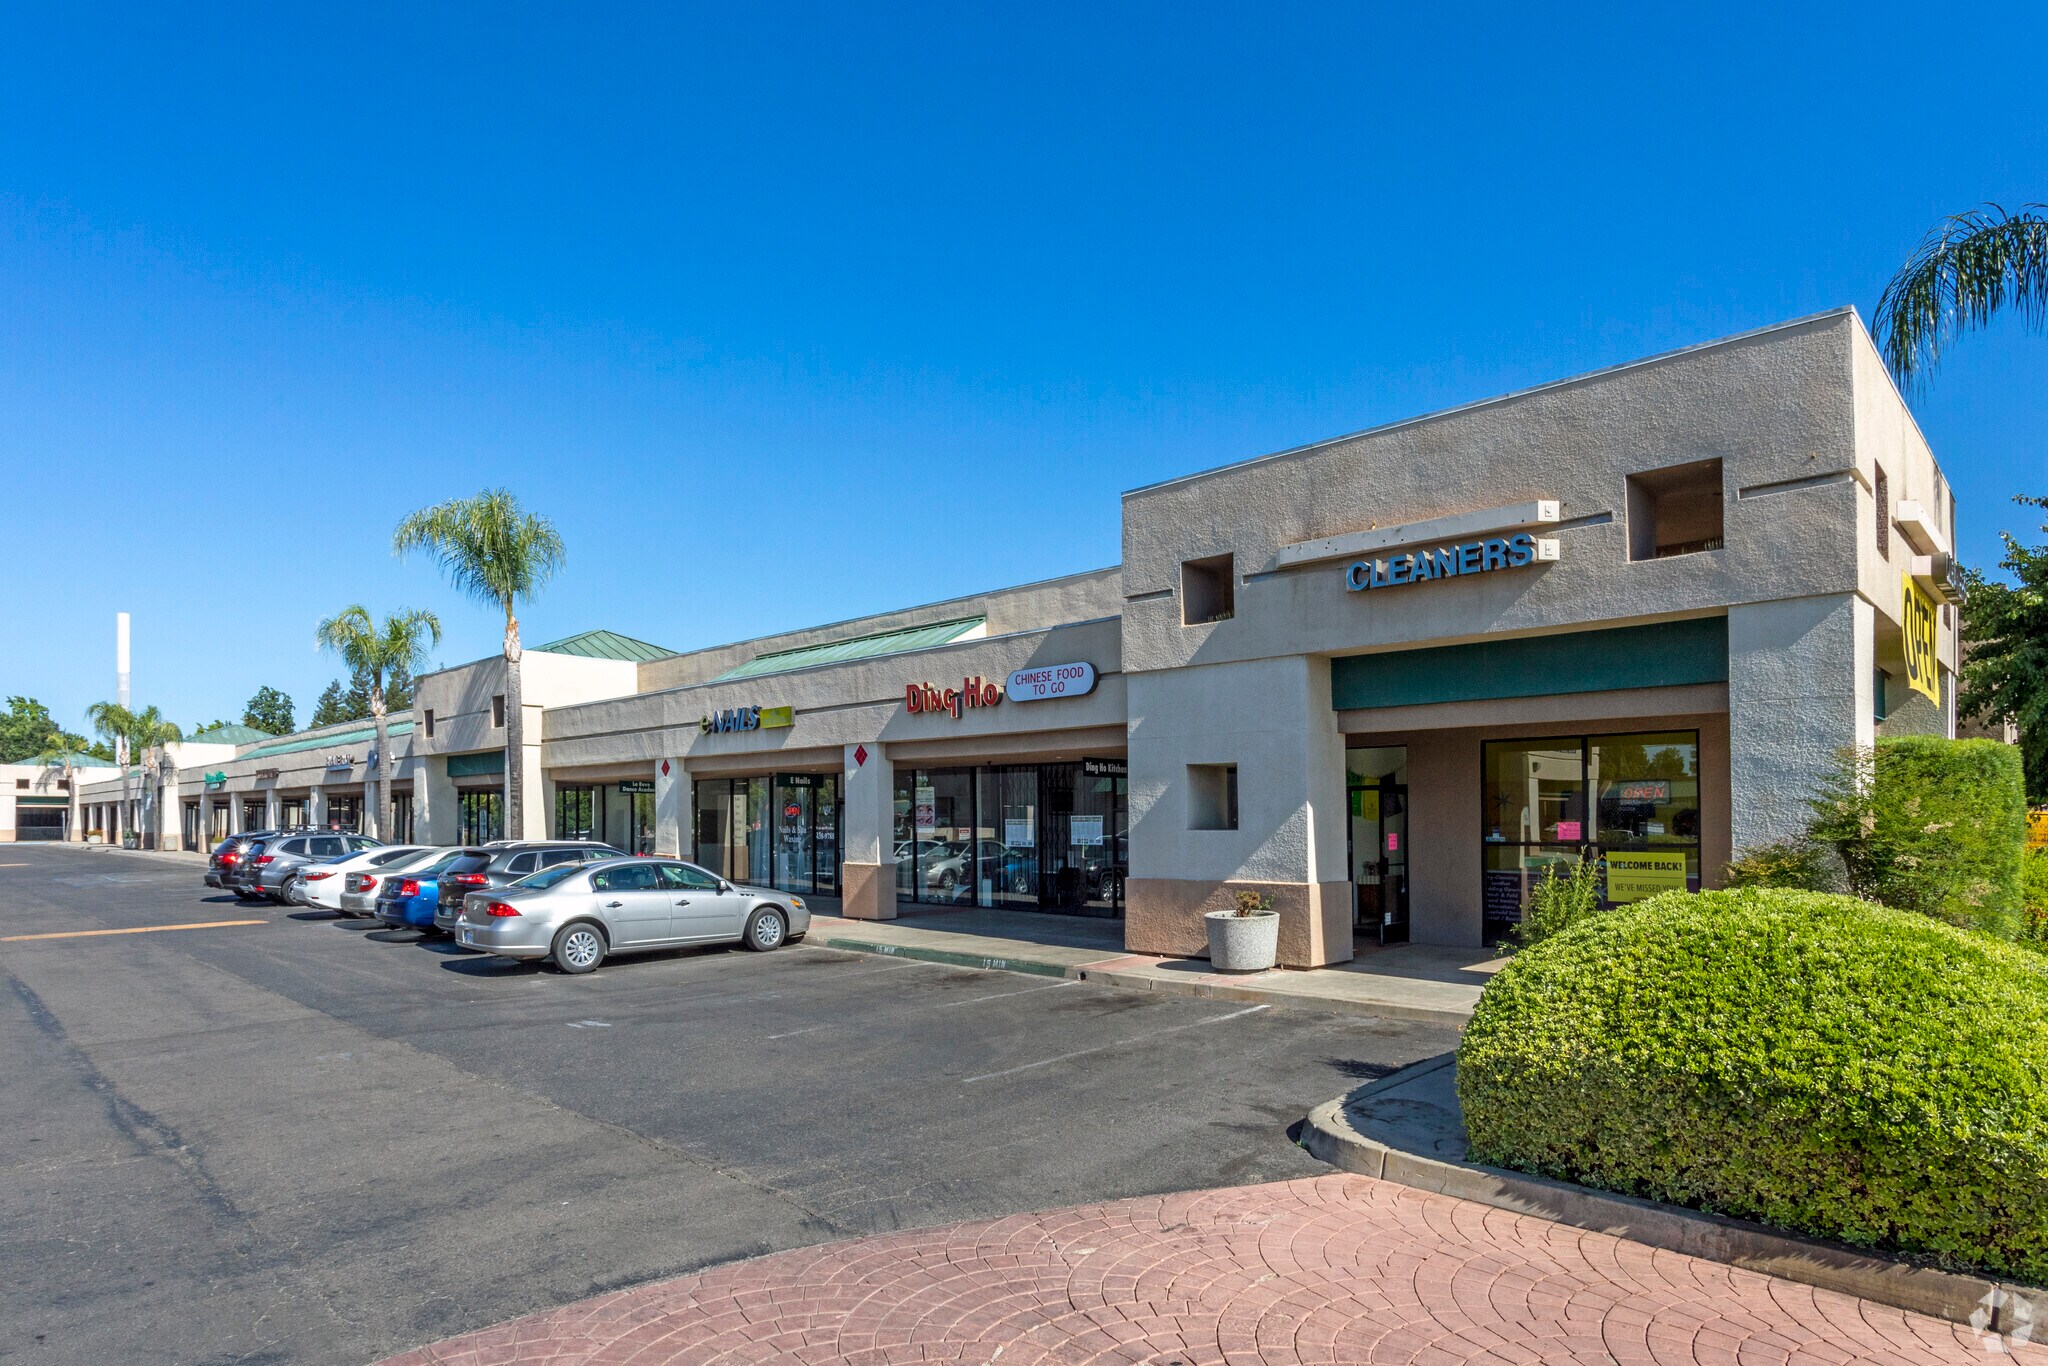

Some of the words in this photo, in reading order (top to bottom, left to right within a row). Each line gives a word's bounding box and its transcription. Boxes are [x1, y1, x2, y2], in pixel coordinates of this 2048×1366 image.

[1346, 533, 1537, 591] CLEANERS
[1014, 670, 1052, 686] CHINESE
[1057, 666, 1084, 681] FOOD
[1033, 684, 1046, 696] TO
[1051, 681, 1065, 693] GO
[906, 682, 960, 719] Ding
[964, 675, 1000, 708] Ho
[1085, 761, 1099, 774] Ding
[1099, 763, 1107, 772] Ho
[790, 776, 794, 784] E
[795, 776, 811, 784] Nails
[1623, 786, 1665, 799] OPEN
[792, 826, 797, 834] &
[1610, 861, 1653, 871] WELCOME
[1654, 861, 1683, 871] BACK!
[1615, 883, 1635, 892] WE'VE
[1636, 884, 1661, 893] MISSED
[883, 946, 895, 954] MIN
[983, 957, 991, 968] 15
[993, 959, 1006, 969] MIN
